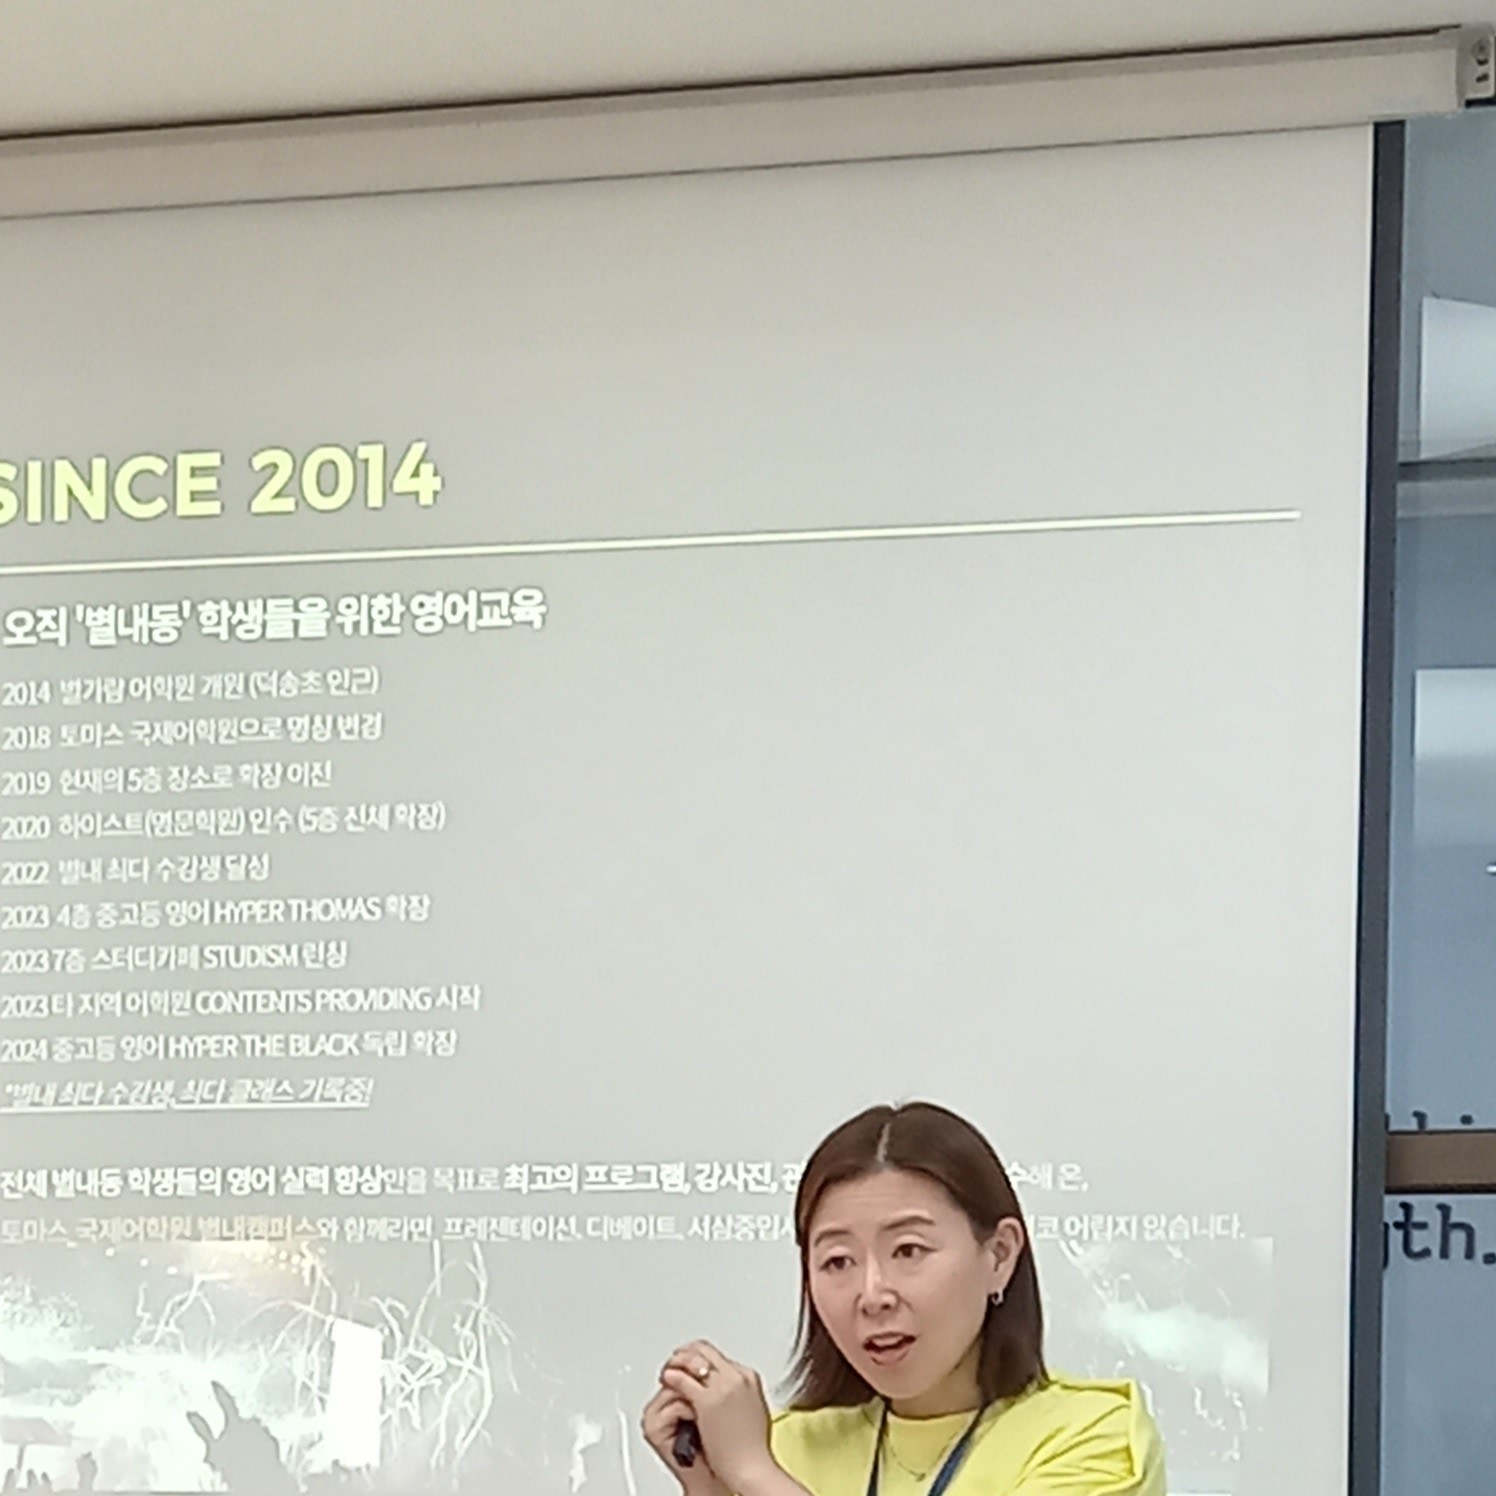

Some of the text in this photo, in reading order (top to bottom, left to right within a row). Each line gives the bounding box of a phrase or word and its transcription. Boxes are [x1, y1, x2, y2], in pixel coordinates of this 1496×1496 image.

[249, 441, 443, 515] 2014
[2, 588, 547, 647] 오직 '별내동' 학생들을 위한 영어교육
[1, 680, 51, 706] 2014
[129, 673, 195, 703] 어학원
[200, 671, 245, 700] 개원
[1, 726, 52, 751] 2018
[59, 722, 125, 749] 토마스
[1, 771, 51, 796] 2019
[127, 765, 162, 793] 5층
[167, 763, 233, 793] 장소로
[1, 815, 51, 841] 2020
[249, 806, 293, 835] 인수
[1, 860, 50, 886] 2022
[58, 857, 103, 885] 별내
[156, 854, 221, 883] 수강생
[225, 852, 270, 881] 달성
[1, 904, 50, 930] 2023
[96, 900, 161, 929] 중고등
[214, 899, 285, 924] HYPER
[288, 897, 382, 923] THOMAS
[0, 949, 49, 974] 2023
[90, 944, 199, 973] 스터디카페
[203, 941, 300, 970] STUDISM
[0, 994, 48, 1019] 2023
[78, 990, 122, 1018] 지역
[195, 986, 312, 1015] CONTENTS
[315, 985, 432, 1013] PROVIDING
[435, 983, 481, 1012] 시작
[0, 1038, 48, 1063] 2024
[52, 1035, 116, 1063] 중고등
[168, 1033, 238, 1059] HYPER
[240, 1033, 286, 1058] THE
[289, 1031, 360, 1058] BLACK
[0, 1168, 48, 1199] 전체
[52, 1167, 124, 1199] 별내동
[127, 1165, 222, 1198] 학생들의
[226, 1164, 276, 1197] 영어
[280, 1164, 330, 1195] 실력
[503, 1162, 579, 1195] 최고의
[582, 1161, 691, 1195] 프로그램,
[694, 1161, 779, 1195] 강사진,
[1384, 1200, 1496, 1271] th.
